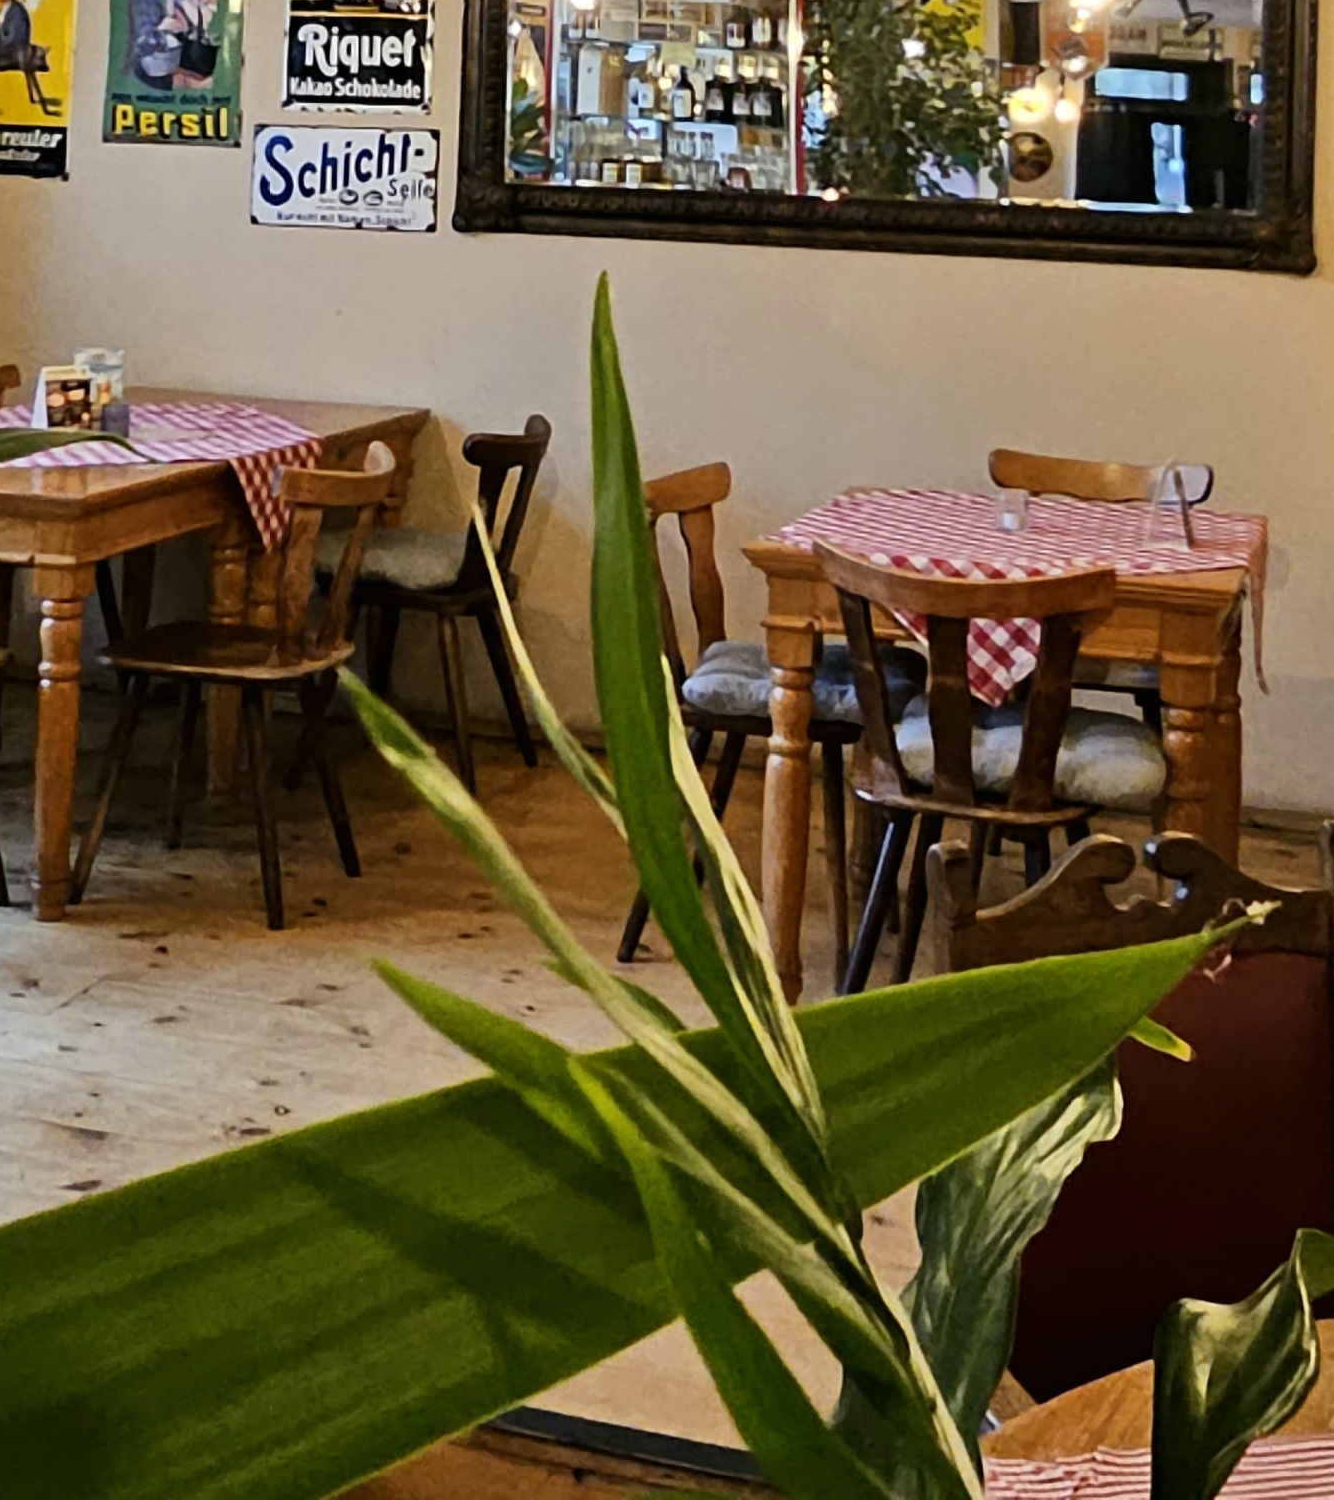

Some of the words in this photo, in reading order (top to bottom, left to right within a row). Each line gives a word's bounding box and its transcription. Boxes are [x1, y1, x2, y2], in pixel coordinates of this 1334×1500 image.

[297, 23, 417, 77] Riquet
[290, 75, 333, 96] Kakao
[334, 77, 421, 99] Schokolade
[112, 103, 228, 139] Persil
[387, 178, 434, 200] Seife
